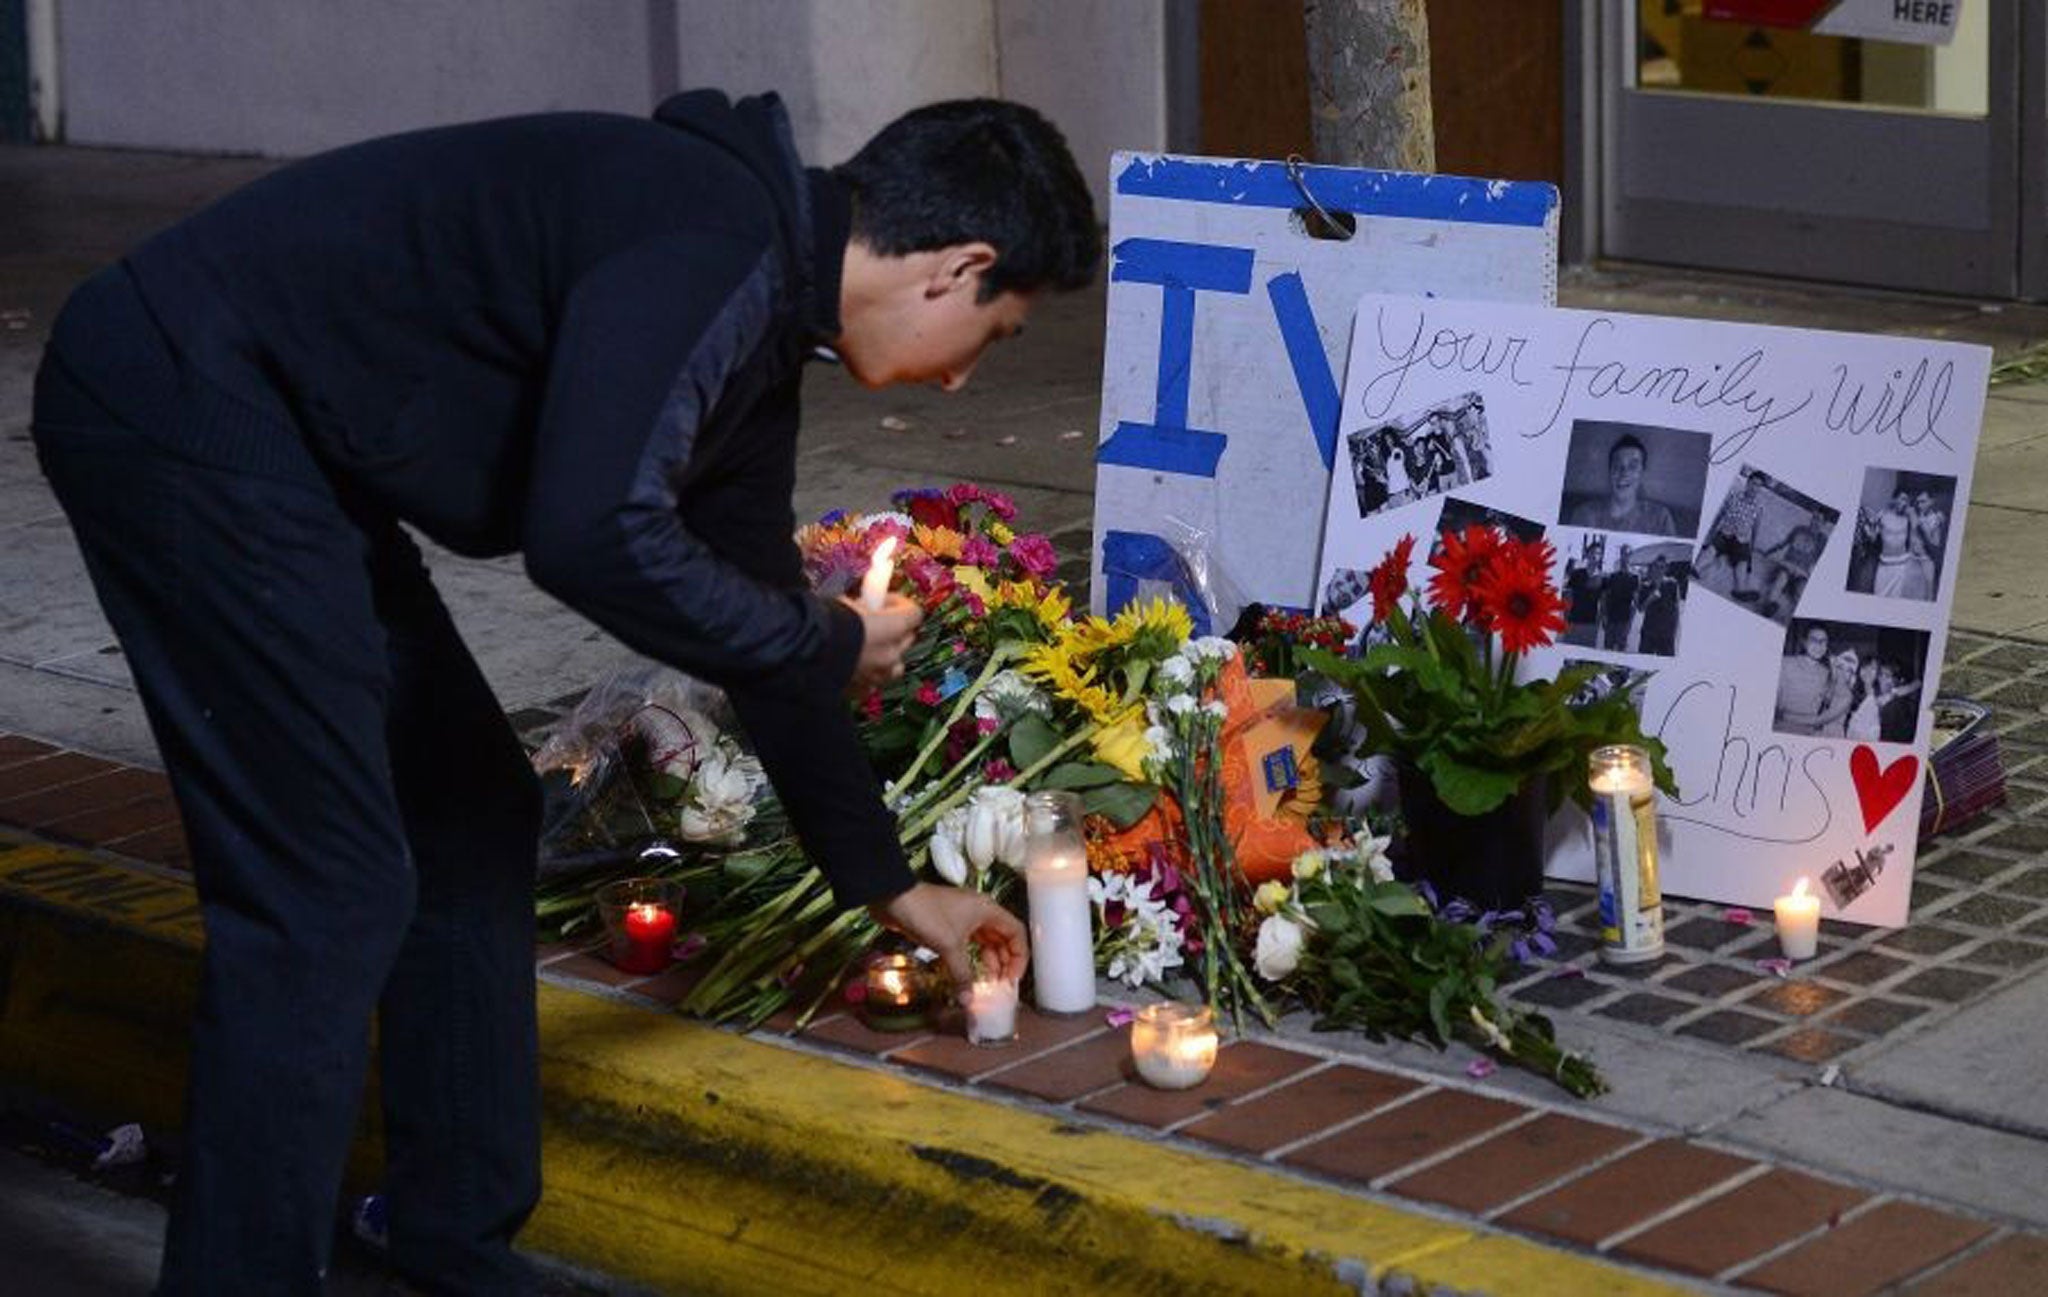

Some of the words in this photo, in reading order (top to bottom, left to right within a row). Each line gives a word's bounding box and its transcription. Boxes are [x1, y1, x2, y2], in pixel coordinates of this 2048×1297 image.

[1894, 0, 1954, 26] HERE
[1520, 318, 1813, 464] family
[1657, 681, 1834, 844] Chris
